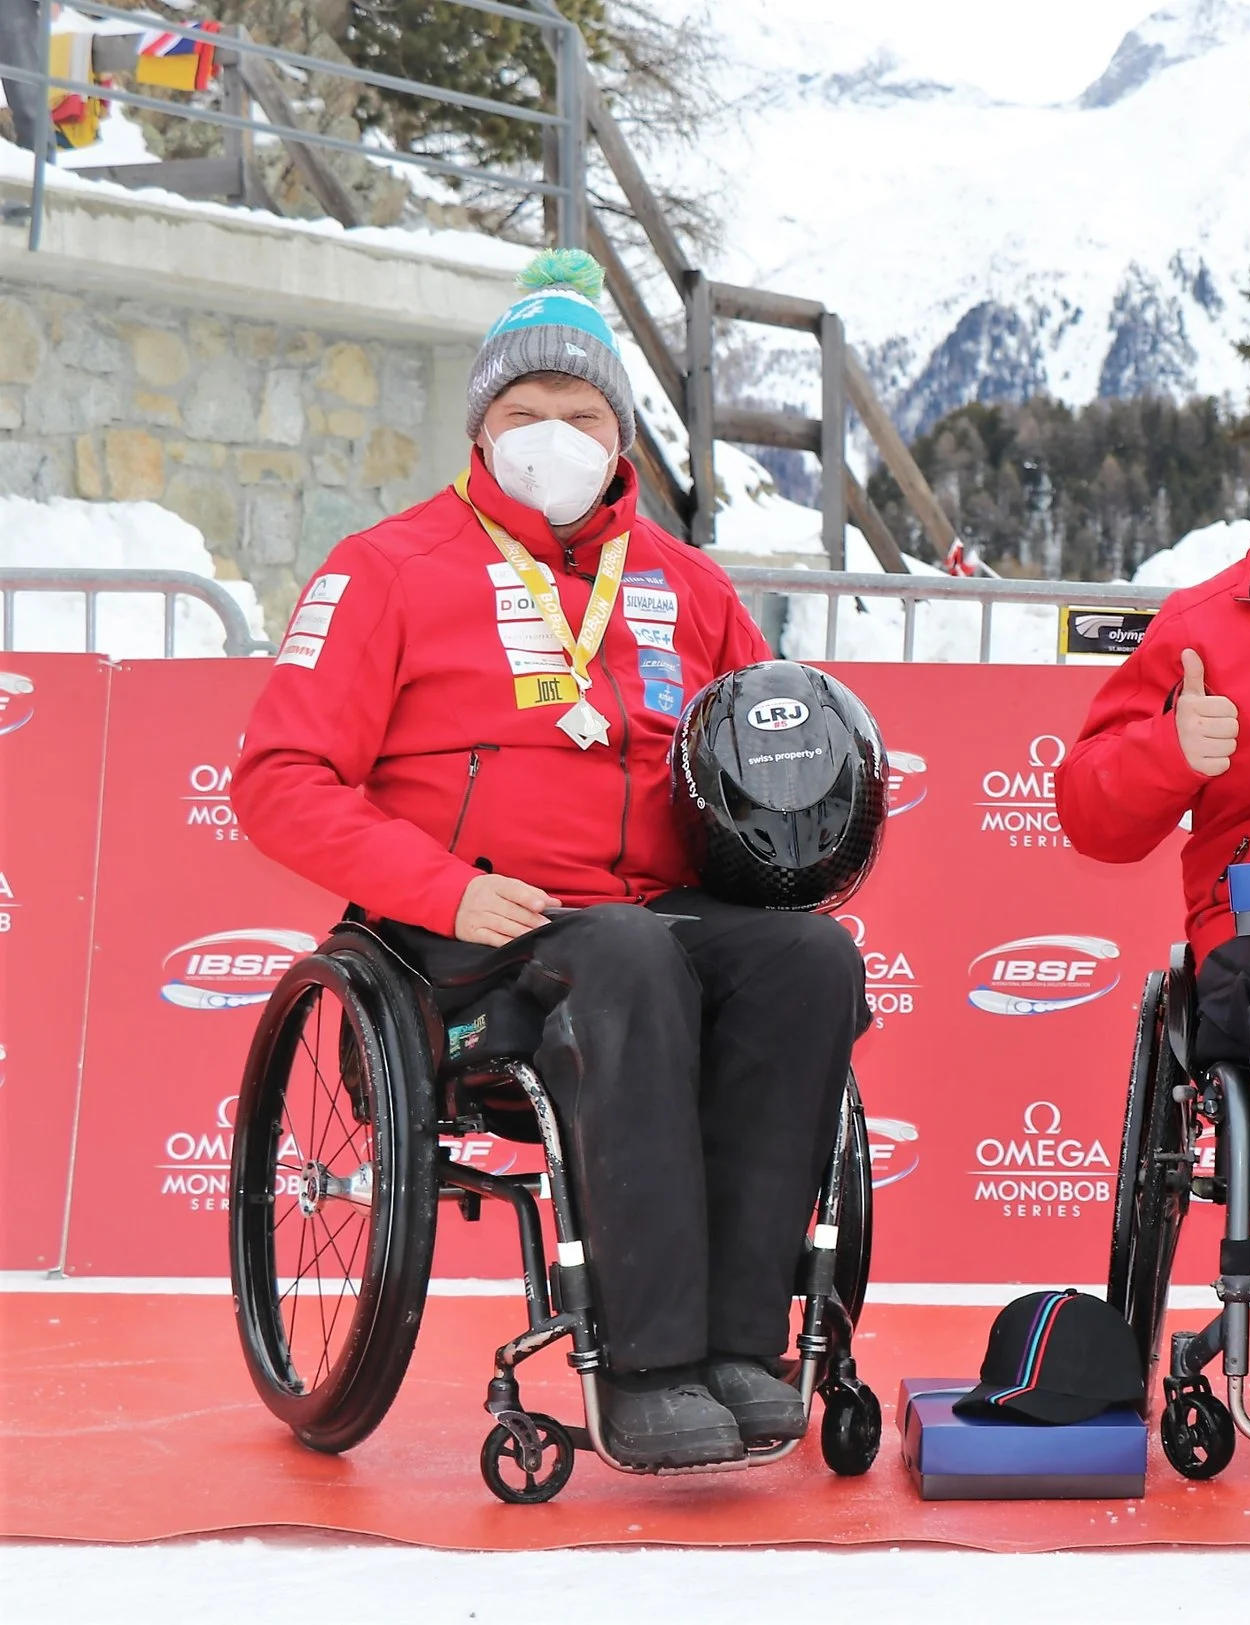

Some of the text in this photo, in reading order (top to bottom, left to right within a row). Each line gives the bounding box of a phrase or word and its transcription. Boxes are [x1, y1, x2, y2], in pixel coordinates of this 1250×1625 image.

[627, 595, 674, 611] SILVAPLANA
[581, 596, 610, 649] BOBRUN
[1108, 628, 1145, 644] olymp
[755, 706, 802, 725] LRJ
[774, 720, 788, 729] #5
[748, 748, 815, 765] swiss property
[982, 770, 1055, 798] OME
[981, 811, 1062, 832] MONO
[1009, 835, 1072, 847] SERIE
[186, 954, 294, 976] IBSF
[992, 960, 1097, 981] IBSF
[976, 1138, 1111, 1168] OMEGA
[975, 1180, 1111, 1202] MONOBOB
[191, 1198, 230, 1211] SER
[1003, 1204, 1081, 1217] SERIES
